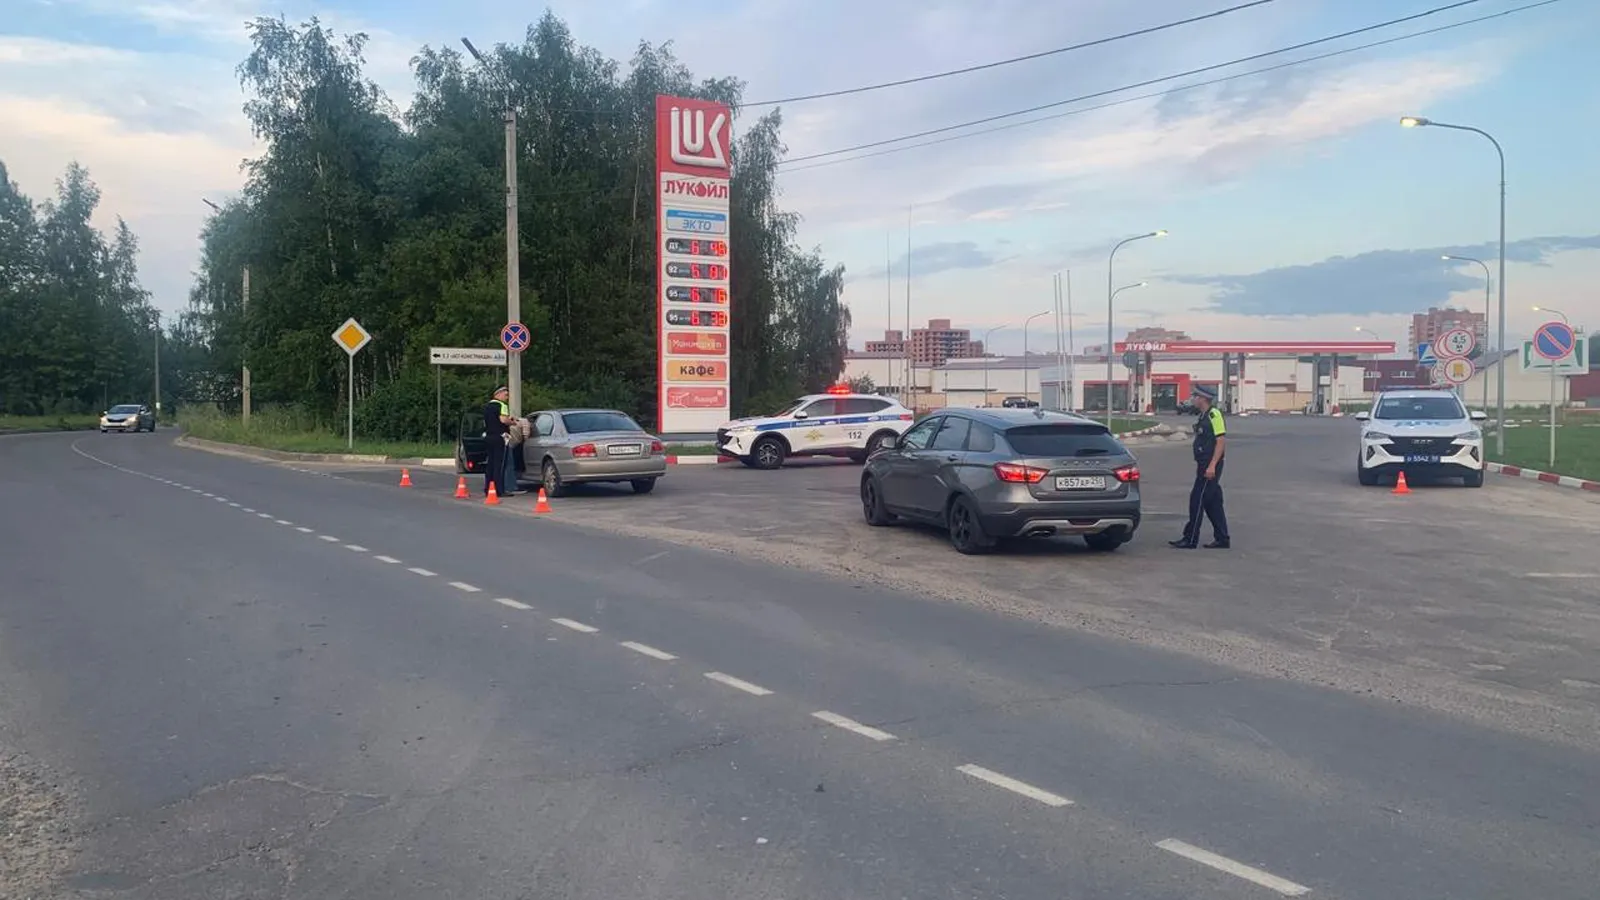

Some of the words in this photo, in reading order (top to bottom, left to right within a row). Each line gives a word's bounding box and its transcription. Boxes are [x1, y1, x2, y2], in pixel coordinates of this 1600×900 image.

[664, 179, 728, 199] ЛУКОЙЛ
[1125, 341, 1167, 351] ЛУКОЙЛ
[680, 365, 715, 377] кафе
[848, 431, 863, 440] 112
